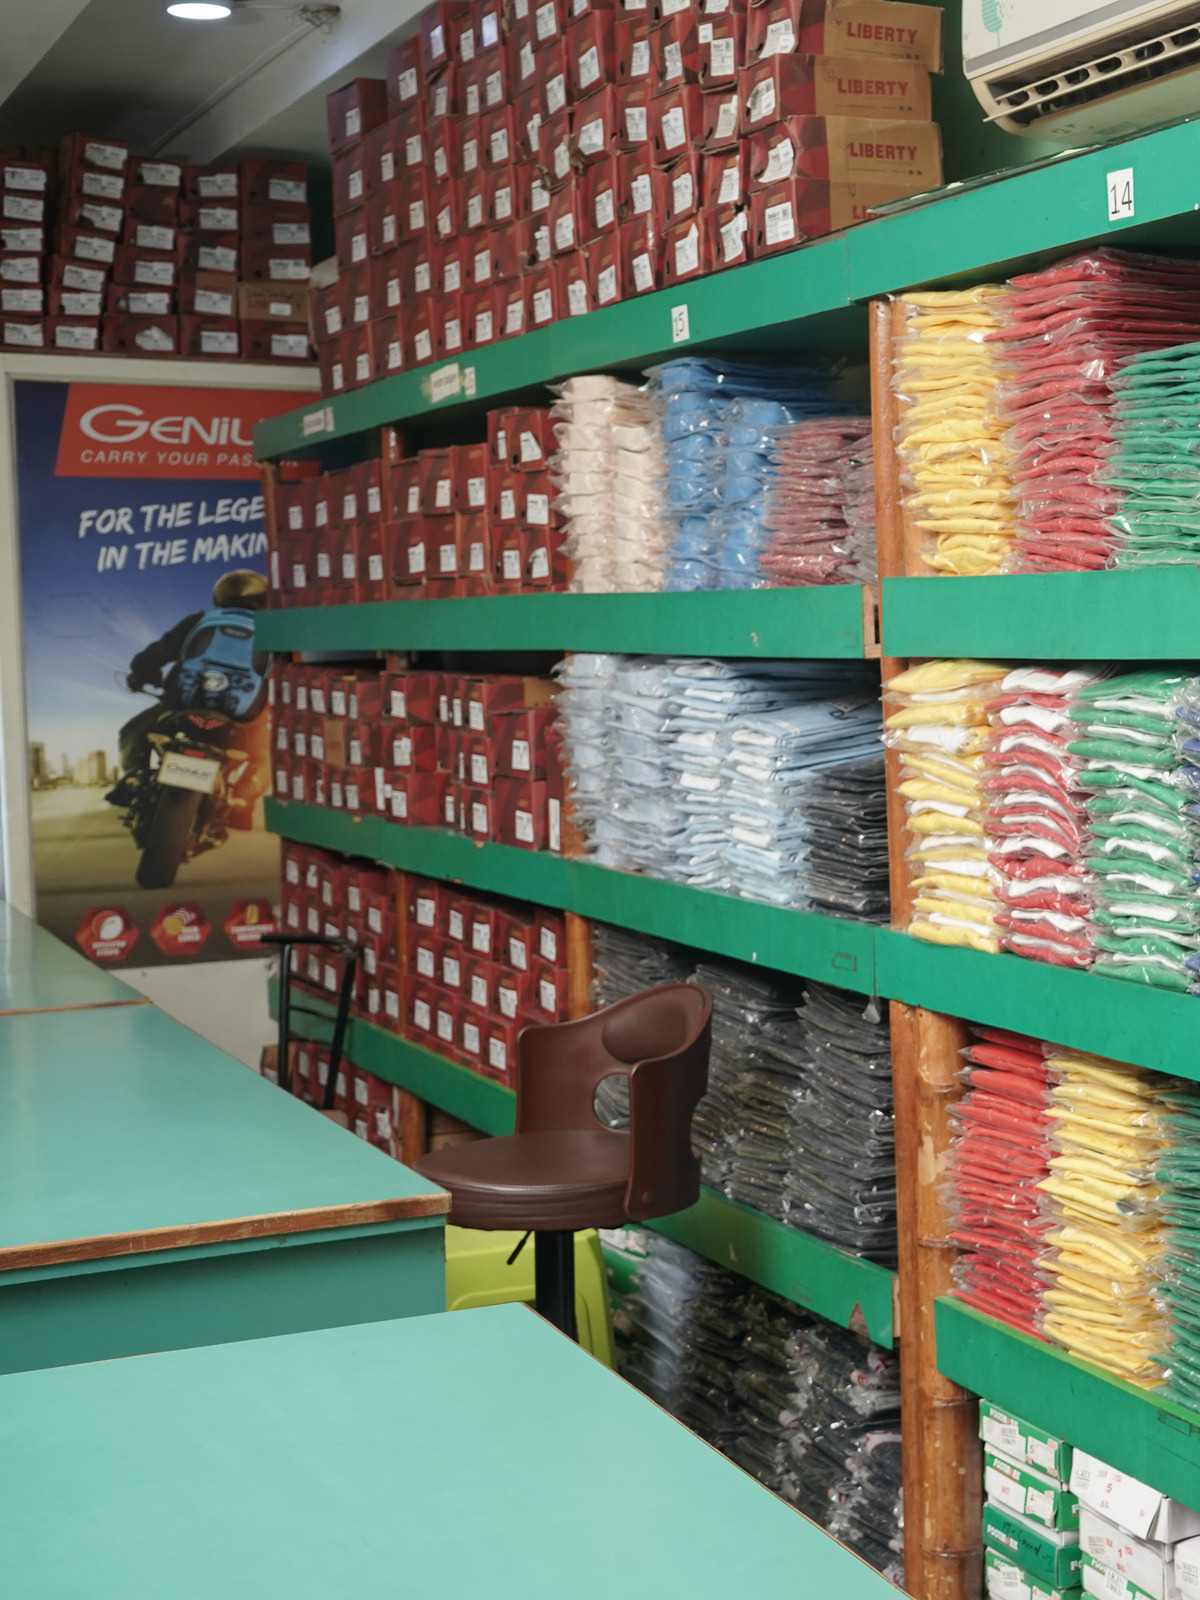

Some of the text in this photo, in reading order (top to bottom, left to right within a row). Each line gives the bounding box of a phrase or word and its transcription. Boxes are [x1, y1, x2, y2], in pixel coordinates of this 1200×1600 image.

[846, 22, 919, 45] LIBERTY
[837, 78, 910, 97] LIBERTY
[849, 142, 918, 161] LIBERTY
[1110, 180, 1133, 215] 14
[673, 311, 686, 337] 15
[80, 449, 149, 465] CARRY
[157, 451, 210, 466] YOUR
[78, 495, 266, 539] FOR THE LEGE
[97, 531, 269, 573] IN THE MAKIN
[1105, 1483, 1113, 1493] 5
